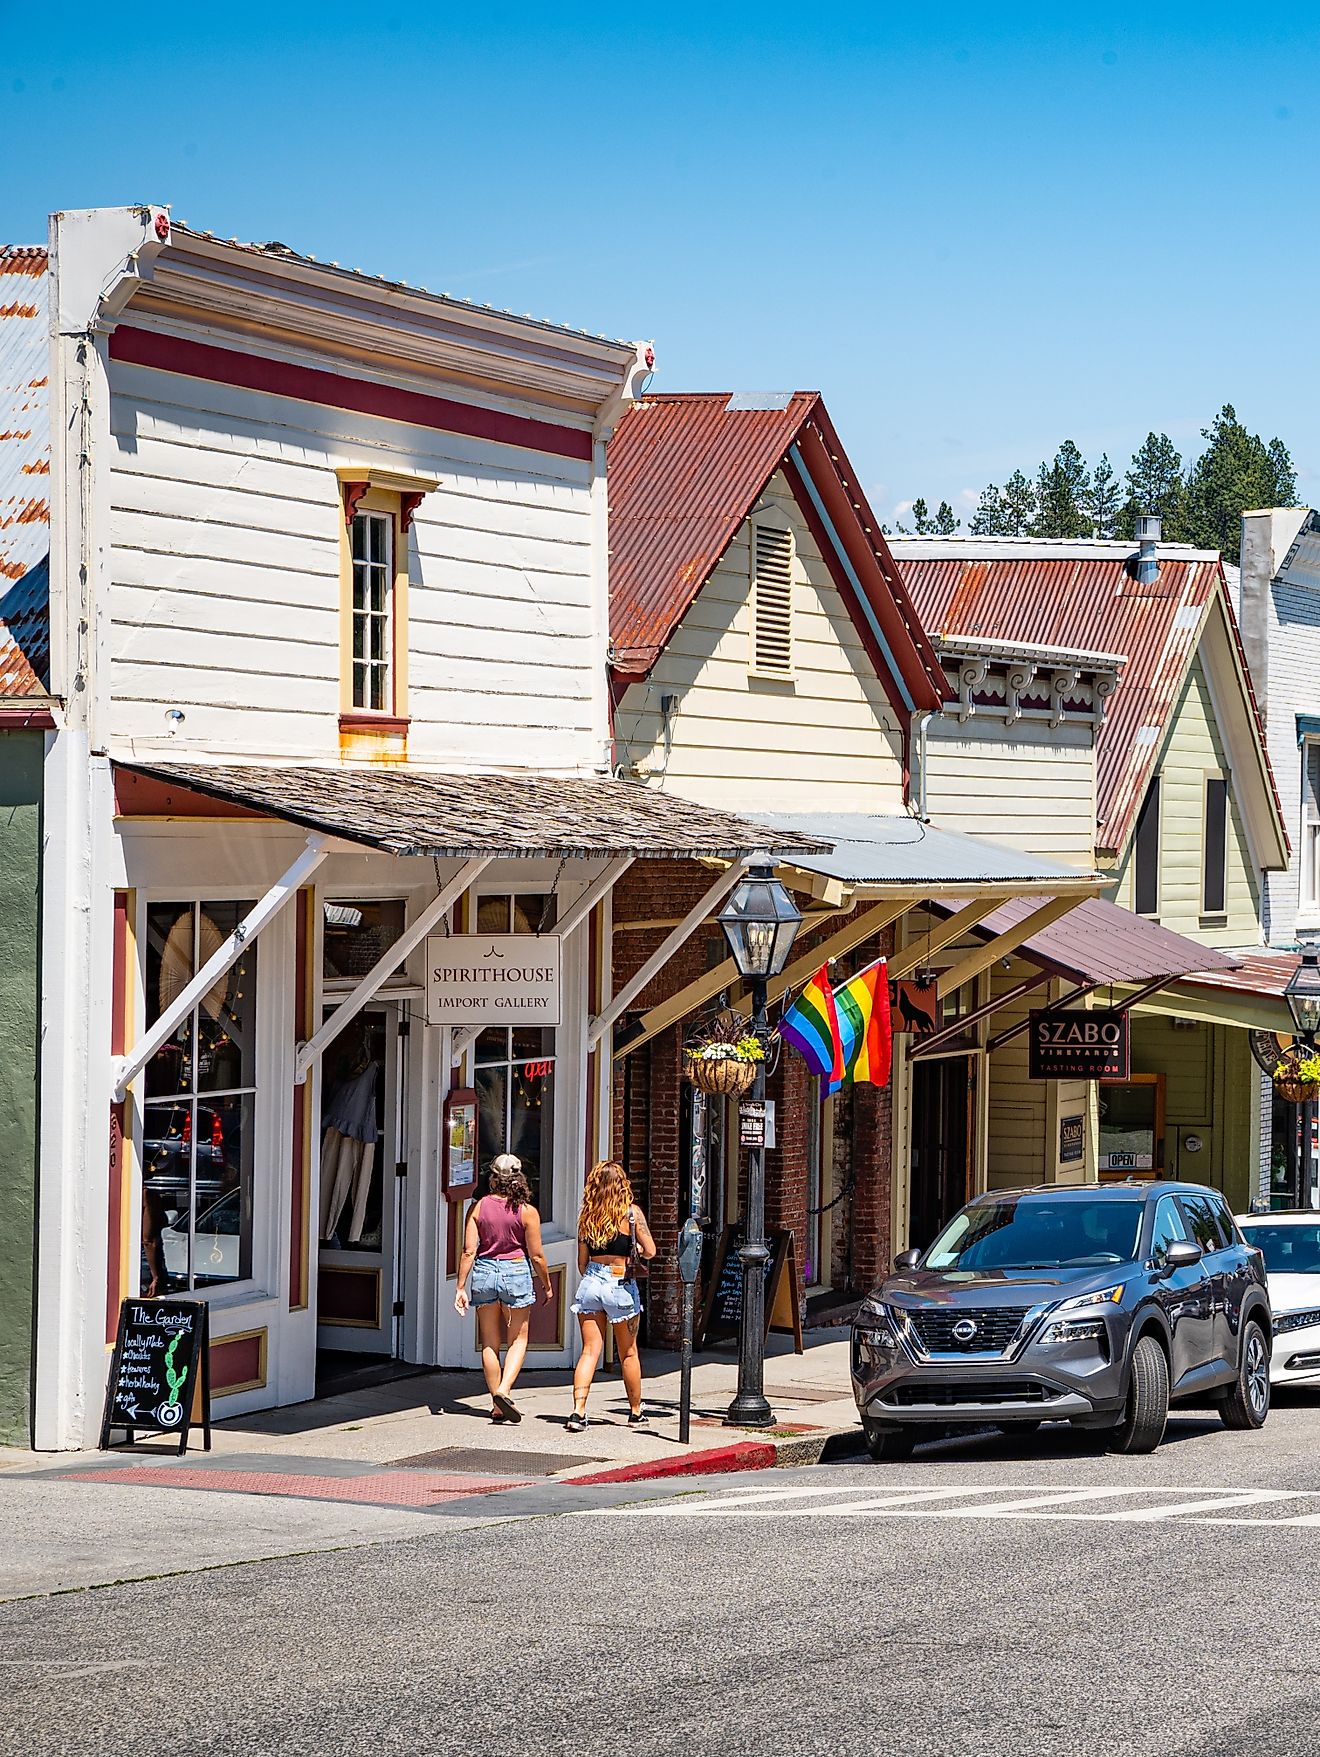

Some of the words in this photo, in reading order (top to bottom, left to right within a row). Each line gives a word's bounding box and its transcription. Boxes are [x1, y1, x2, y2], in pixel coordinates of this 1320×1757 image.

[433, 968, 554, 983] SPIRITHOUSE
[438, 997, 489, 1008] IMPORT
[494, 997, 550, 1008] GALLERY
[1038, 1022, 1120, 1043] SZABO
[1040, 1049, 1119, 1057] VINEYARDS
[1040, 1064, 1083, 1072] TASTING
[1089, 1065, 1119, 1073] ROOM
[1111, 1154, 1134, 1166] OPEN
[131, 1307, 154, 1324] The
[155, 1308, 192, 1327] Garden
